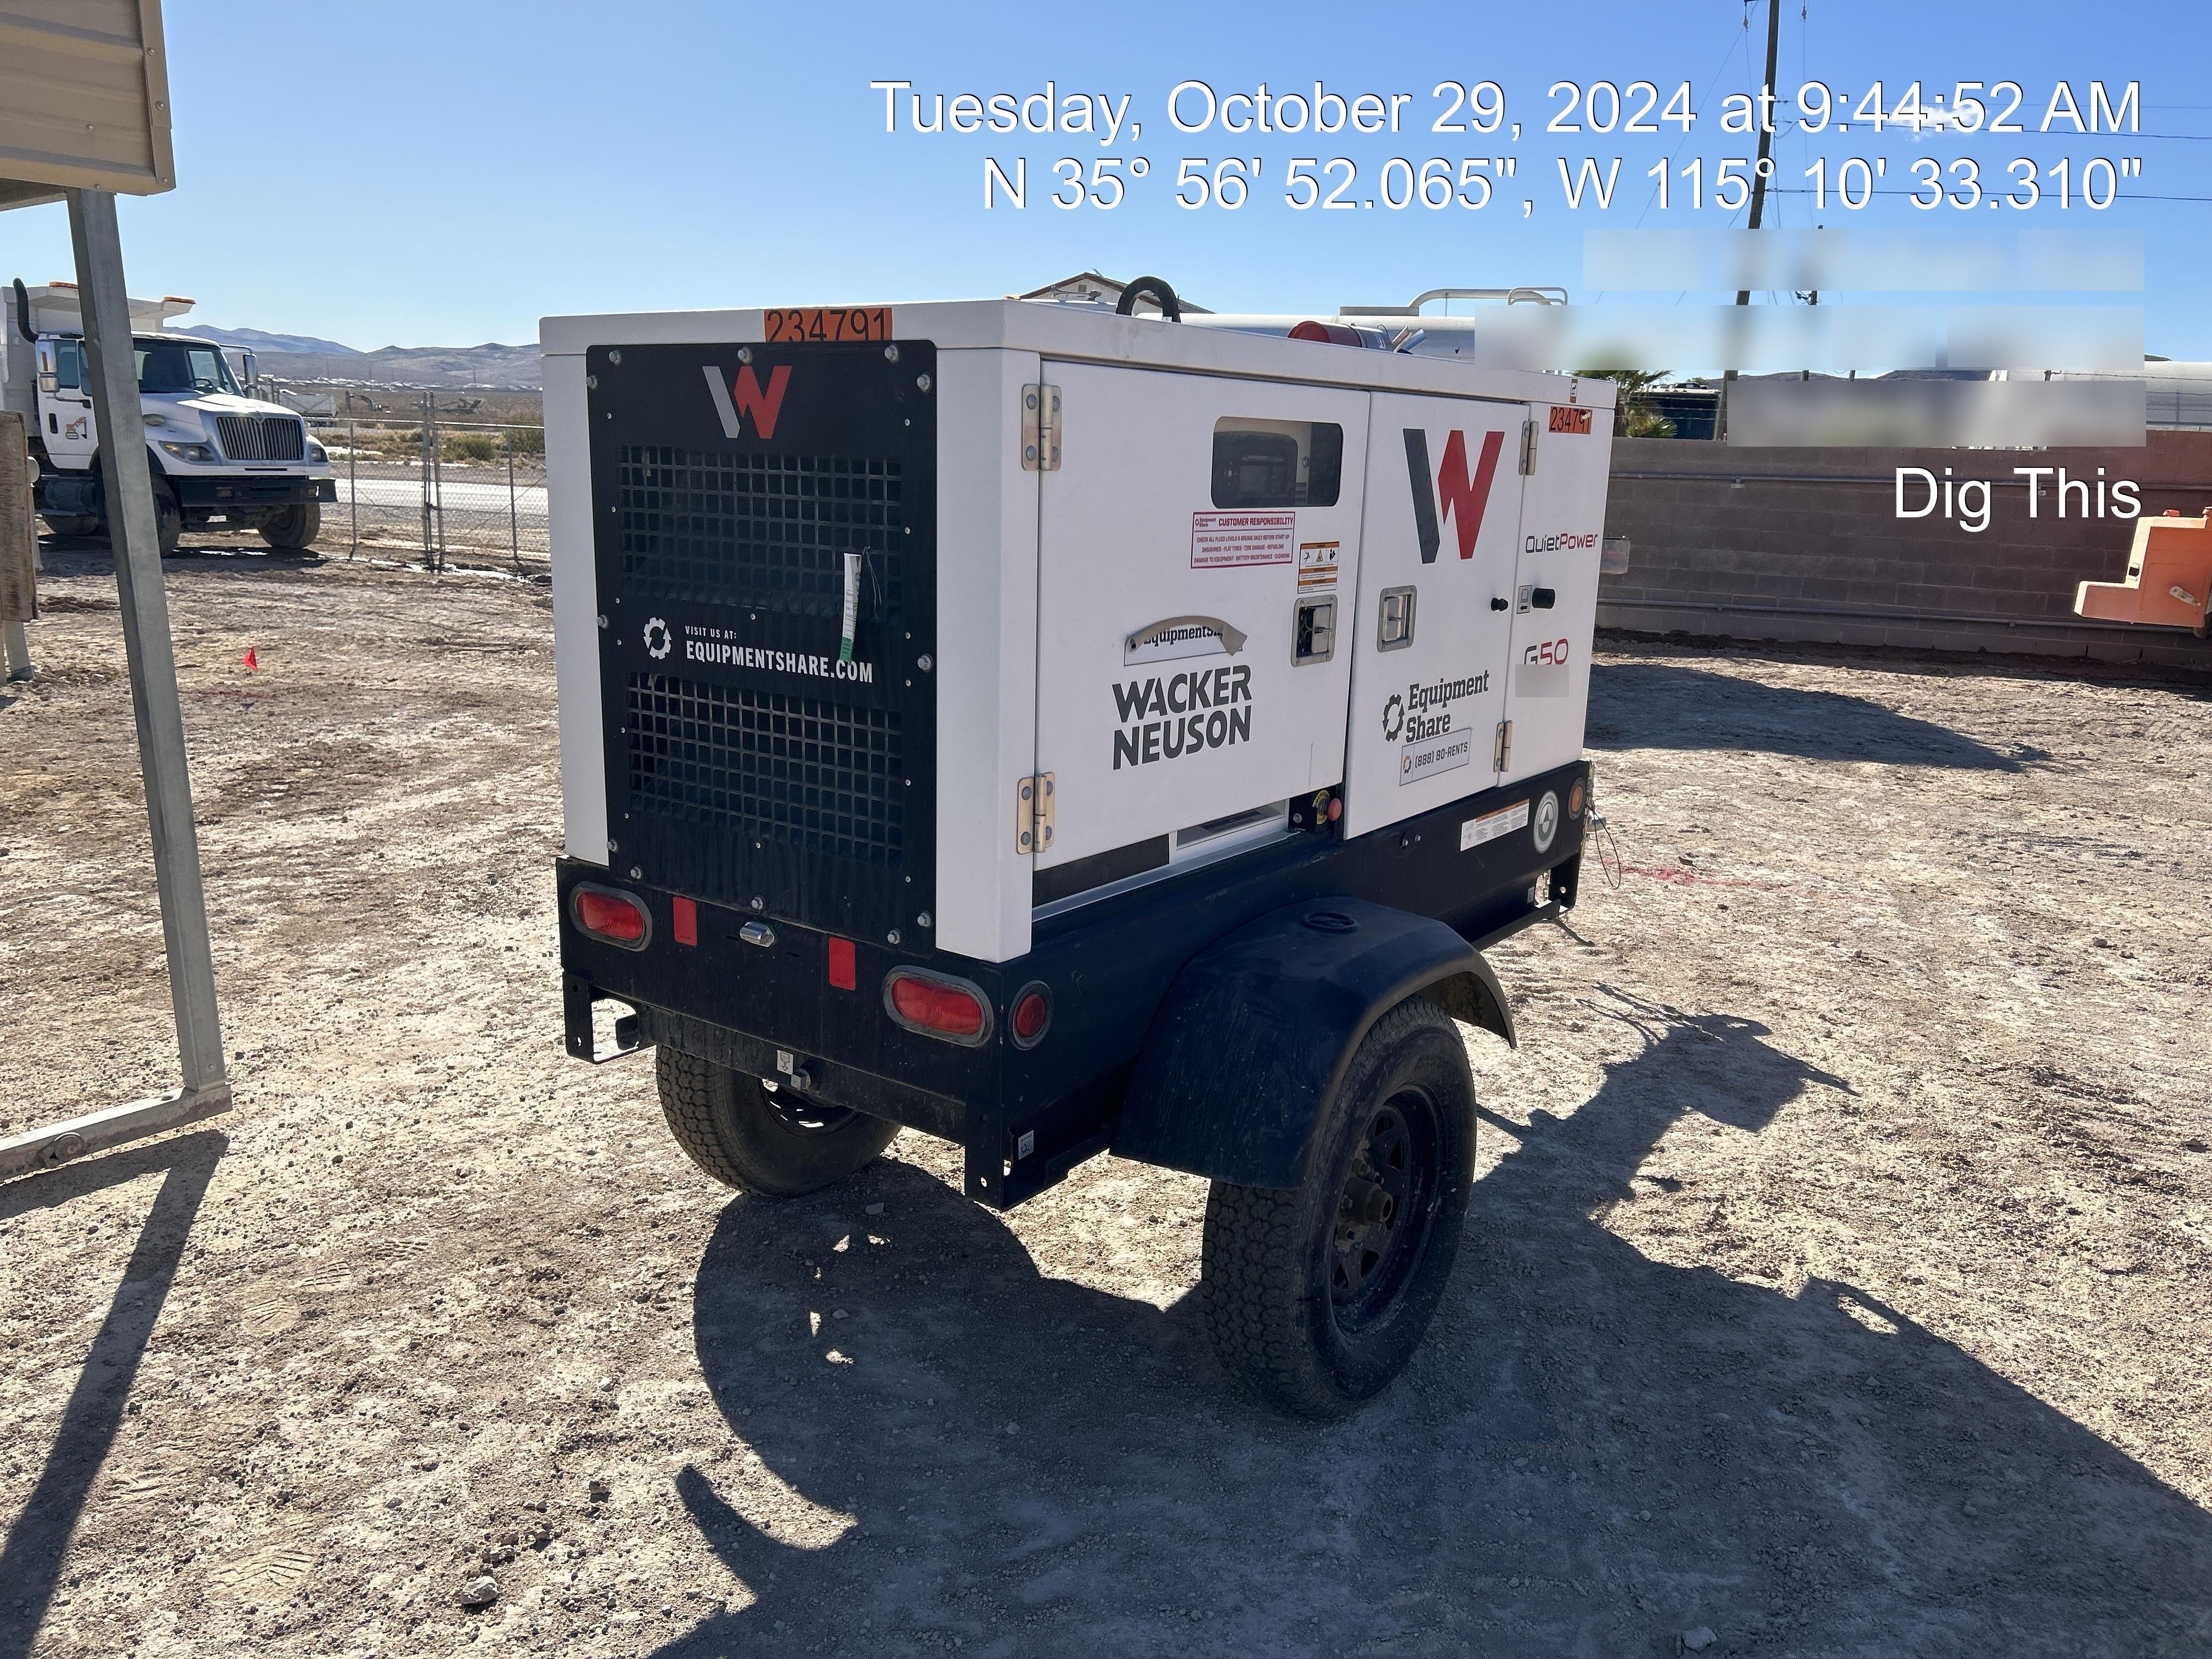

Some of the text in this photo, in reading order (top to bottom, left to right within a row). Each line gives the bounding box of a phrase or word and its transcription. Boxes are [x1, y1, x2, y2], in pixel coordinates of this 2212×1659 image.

[767, 308, 885, 341] 234791
[1218, 517, 1293, 527] CUSTOMER RESPONSIBILITY
[1526, 533, 1598, 554] QuietPower
[685, 625, 737, 640] VISIT US AT:
[686, 640, 873, 683] EQUIPMENTSHARE.COM
[1524, 638, 1568, 665] G50
[1112, 665, 1252, 723] WACKER
[1408, 670, 1489, 713] Equipment
[1113, 705, 1251, 770] NEUSON
[1406, 713, 1451, 743] Share
[1415, 750, 1434, 768] (888)
